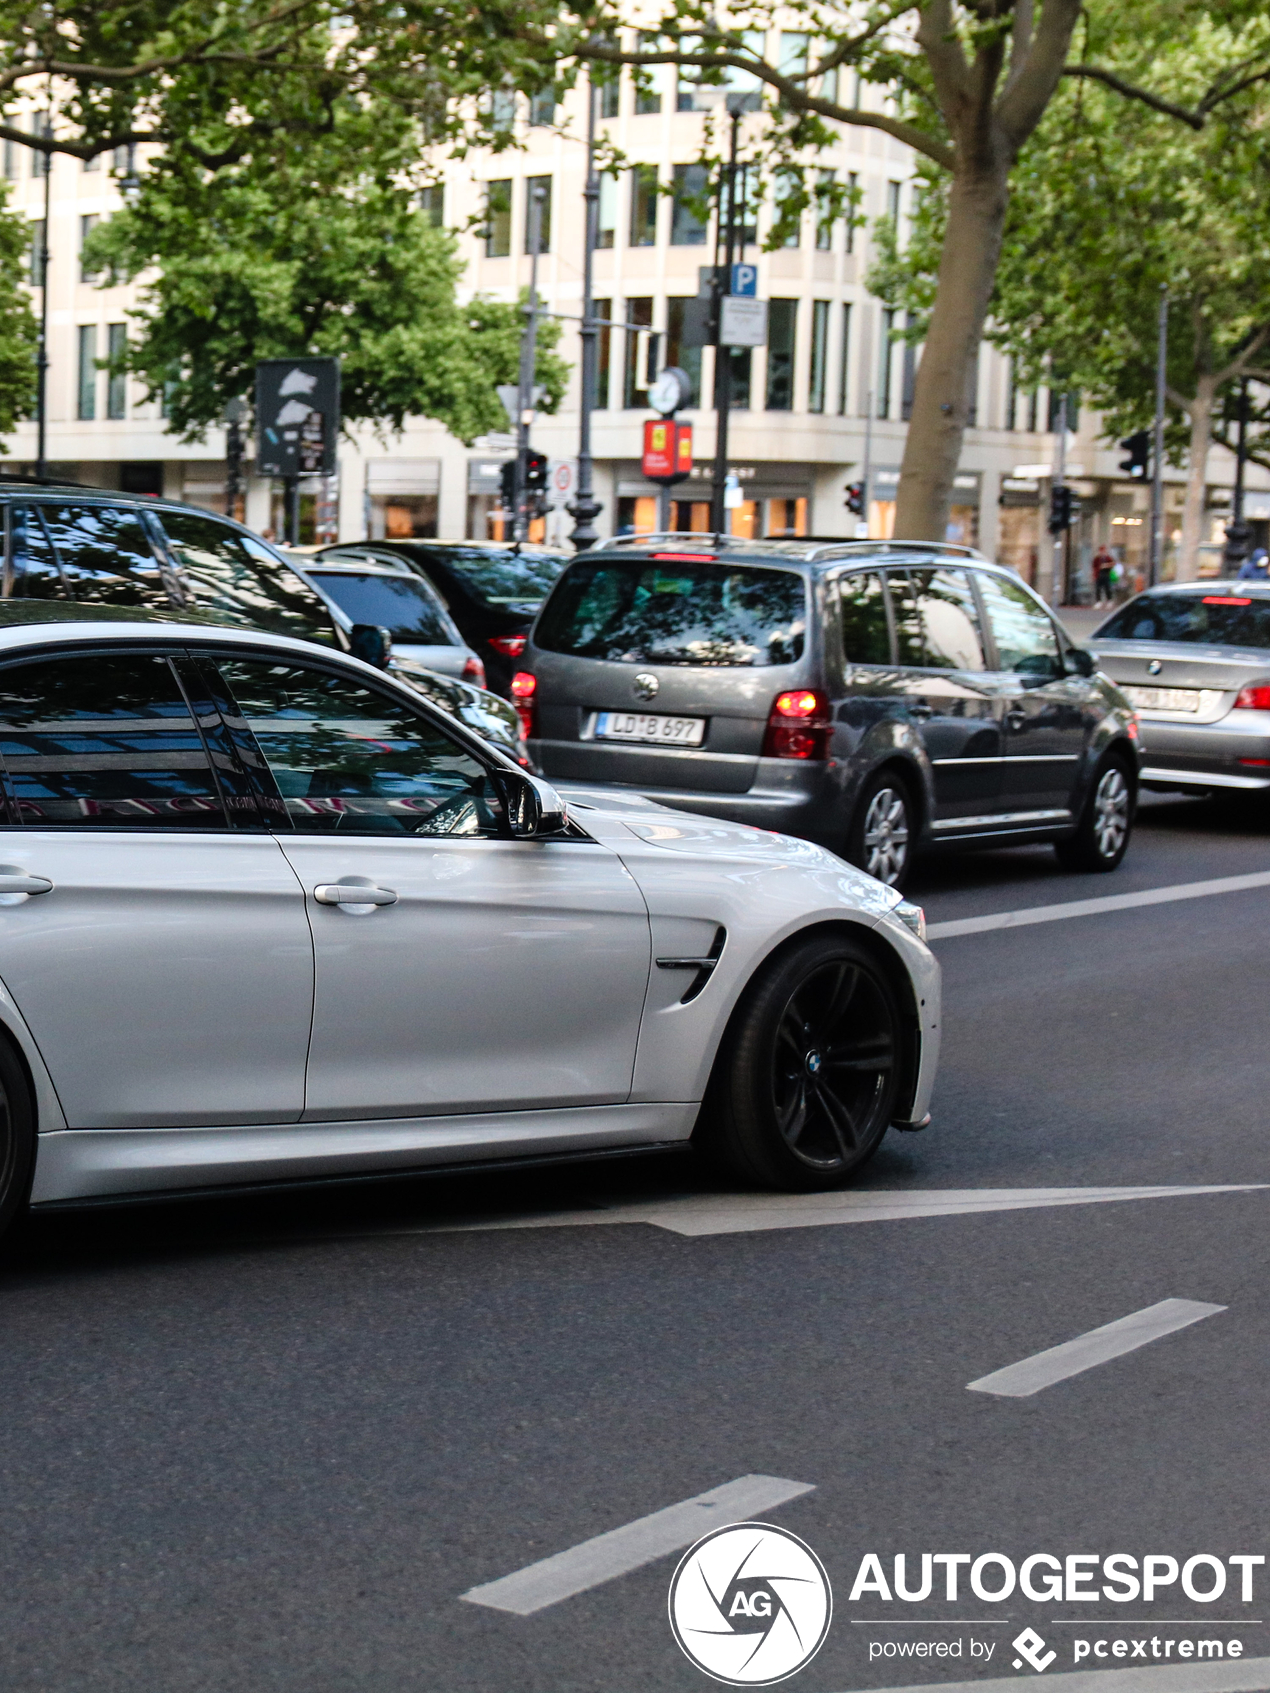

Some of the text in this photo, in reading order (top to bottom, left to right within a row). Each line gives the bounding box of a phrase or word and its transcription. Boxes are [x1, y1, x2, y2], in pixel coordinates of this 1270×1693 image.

[736, 267, 755, 293] P
[613, 715, 635, 734] LD
[662, 720, 696, 738] 697
